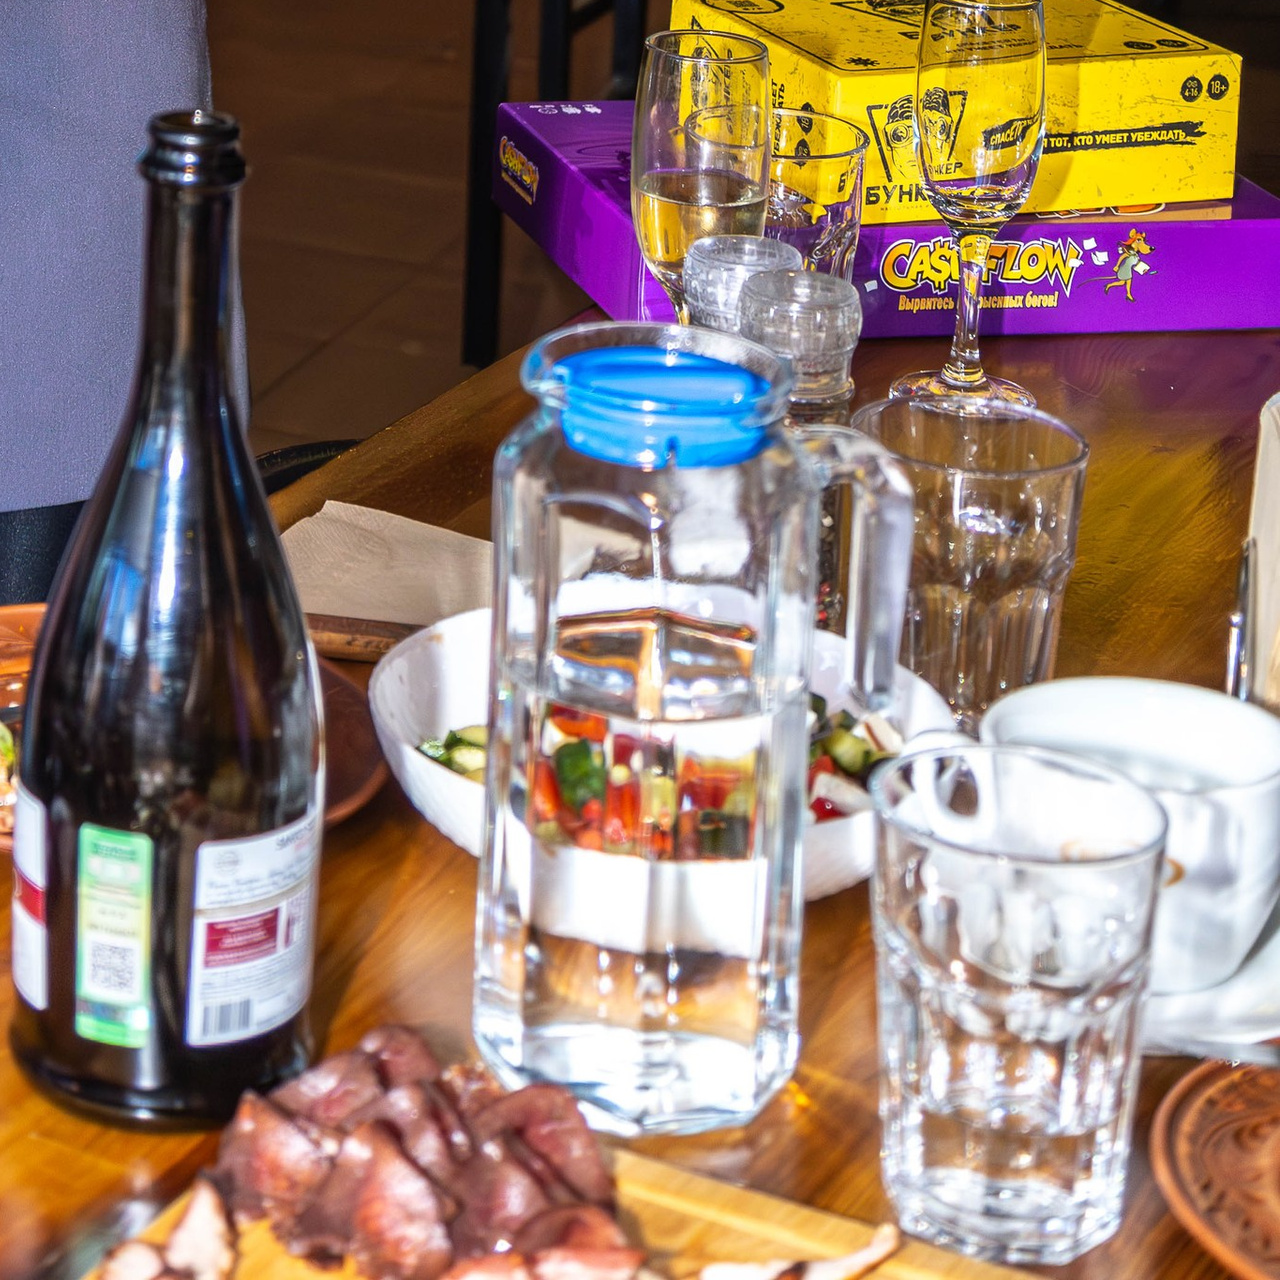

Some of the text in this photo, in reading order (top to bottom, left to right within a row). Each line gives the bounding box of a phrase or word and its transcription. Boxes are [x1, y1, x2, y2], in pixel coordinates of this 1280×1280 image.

[1210, 80, 1227, 94] 18+
[1049, 136, 1072, 149] ТОТ,
[1073, 134, 1093, 147] КТО
[1095, 132, 1129, 145] УМЕЕТ
[1130, 129, 1187, 143] УБЕЖДАТЬ
